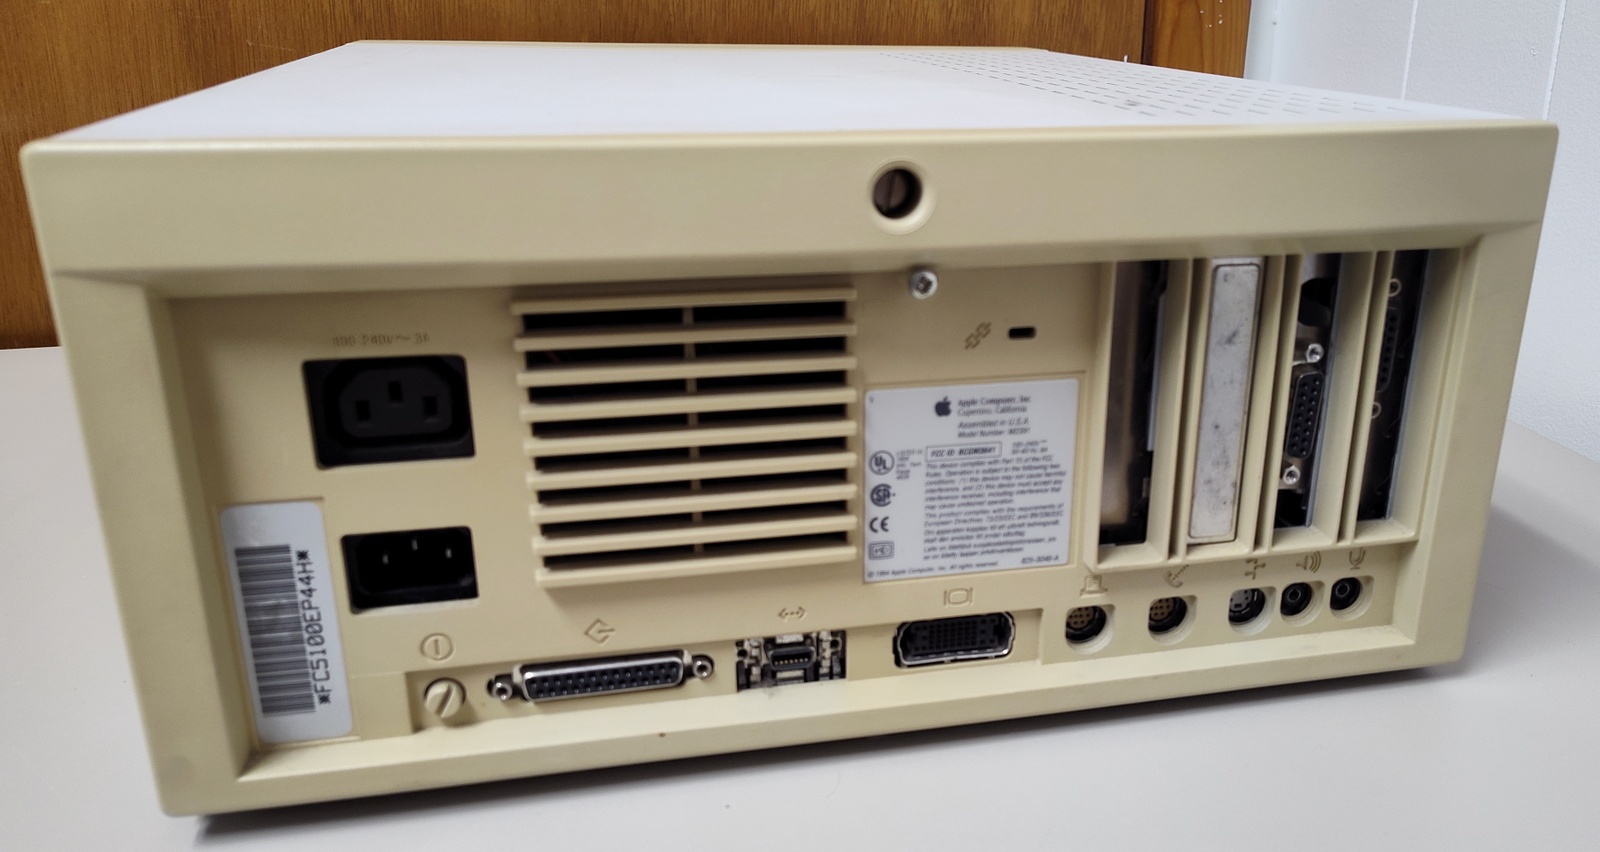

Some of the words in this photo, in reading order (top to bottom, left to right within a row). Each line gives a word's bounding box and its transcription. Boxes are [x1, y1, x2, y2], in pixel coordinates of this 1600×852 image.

[958, 399, 977, 407] Apple
[994, 404, 1027, 414] California
[958, 419, 998, 429] Assembled
[999, 418, 1006, 426] in
[957, 430, 977, 438] Model
[930, 449, 945, 457] FCC
[927, 463, 937, 471] This
[939, 461, 957, 470] device
[959, 459, 985, 468] complies
[987, 458, 998, 466] with
[1001, 457, 1013, 465] Part
[1042, 454, 1053, 462] FCC
[945, 468, 973, 477] Operation
[981, 466, 1002, 474] subject
[1022, 463, 1048, 471] following
[981, 474, 1000, 482] device
[1001, 473, 1013, 481] may
[1015, 472, 1024, 480] not
[1026, 471, 1043, 479] cause
[1044, 469, 1067, 477] harmful
[962, 484, 973, 492] and
[997, 481, 1015, 489] device
[1017, 480, 1031, 488] must
[1033, 478, 1052, 486] accept
[1053, 477, 1063, 485] any
[924, 494, 958, 503] interference
[987, 489, 1014, 498] including
[1016, 486, 1048, 495] interference
[1050, 485, 1061, 493] that
[938, 510, 961, 518] product
[963, 507, 990, 516] complies
[992, 506, 1004, 514] with
[1006, 505, 1015, 513] the
[1017, 502, 1055, 512] requirements
[924, 519, 952, 527] European
[1017, 512, 1027, 520] and
[891, 568, 906, 576] Apple
